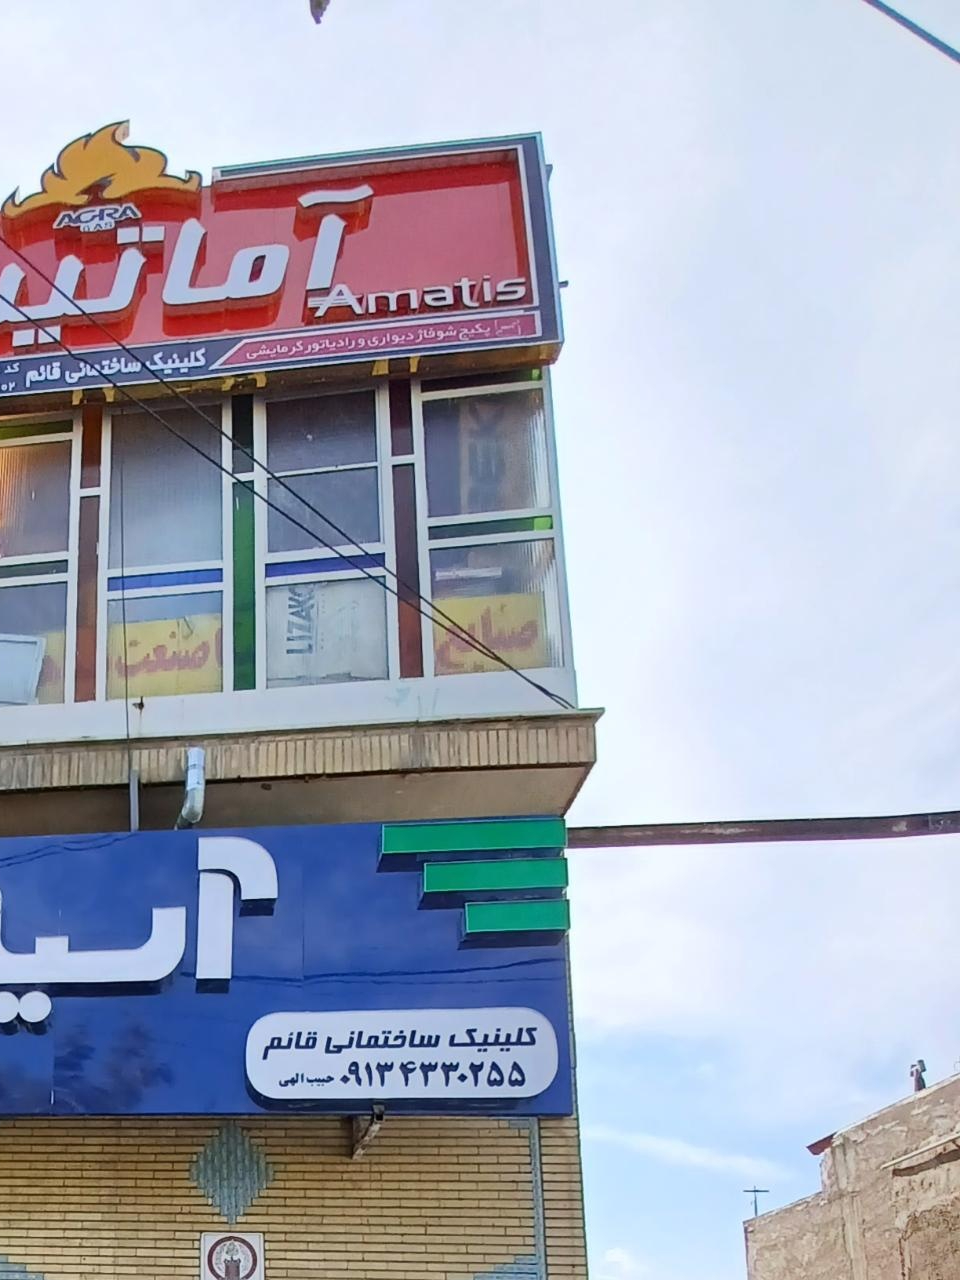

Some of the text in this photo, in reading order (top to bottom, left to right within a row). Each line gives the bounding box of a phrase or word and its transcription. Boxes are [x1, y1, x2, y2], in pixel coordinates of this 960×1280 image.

[308, 275, 527, 318] Amatis
[367, 331, 414, 349] دیواری
[416, 326, 458, 345] شوفاژ
[459, 324, 491, 341] پکیج
[304, 336, 356, 354] رادیاتور
[357, 336, 365, 348] و
[4, 362, 20, 374] کد
[25, 348, 207, 388] کلینیک ساختمانی قائم
[262, 1026, 538, 1061] کلینیک ساختمانی قائم
[306, 1073, 335, 1087] حبیب
